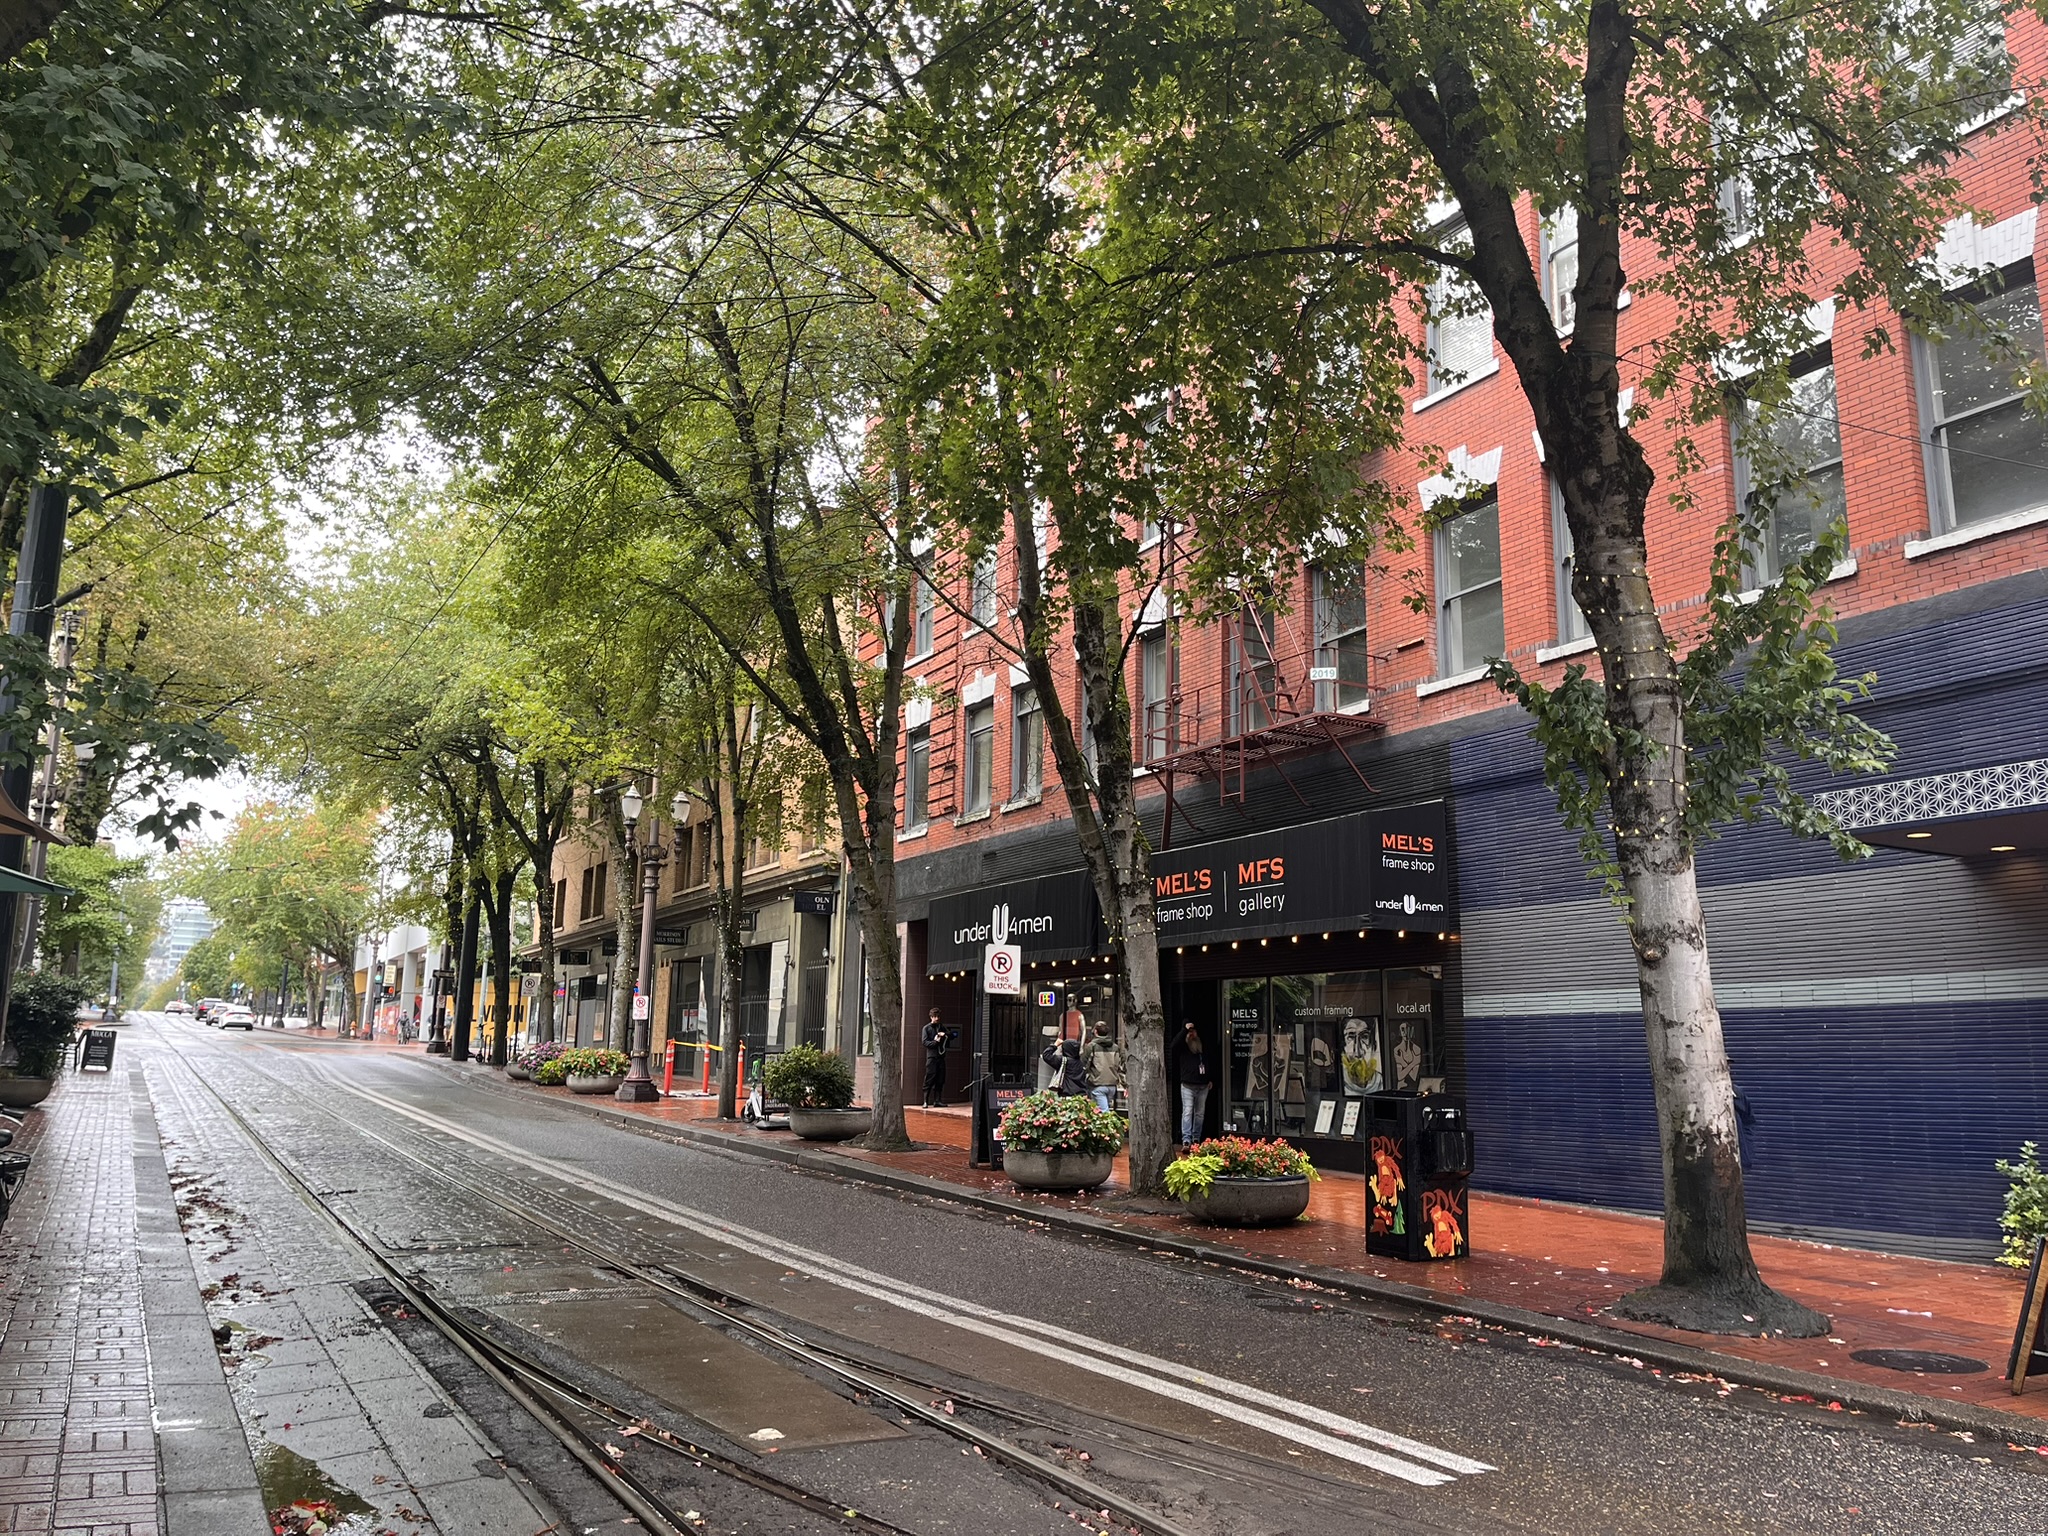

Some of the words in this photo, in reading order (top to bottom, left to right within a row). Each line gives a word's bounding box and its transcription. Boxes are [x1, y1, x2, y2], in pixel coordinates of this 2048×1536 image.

[1312, 669, 1335, 678] 2019
[1382, 833, 1434, 852] MEL'S
[1238, 857, 1285, 884] MFS
[1382, 855, 1409, 870] frame
[1411, 858, 1435, 874] shop
[1156, 868, 1212, 897] MEL'S
[1156, 906, 1184, 923] frame
[1186, 902, 1213, 920] shop
[1239, 892, 1285, 916] gallery
[1232, 1009, 1258, 1018] MEL'S
[1294, 1007, 1321, 1016] custom
[1324, 1005, 1354, 1017] framing
[1396, 1002, 1418, 1013] local
[1419, 1003, 1431, 1013] art
[996, 1090, 1024, 1098] MEL'S
[1370, 1136, 1404, 1160] PDX
[1420, 1188, 1464, 1222] PDX
